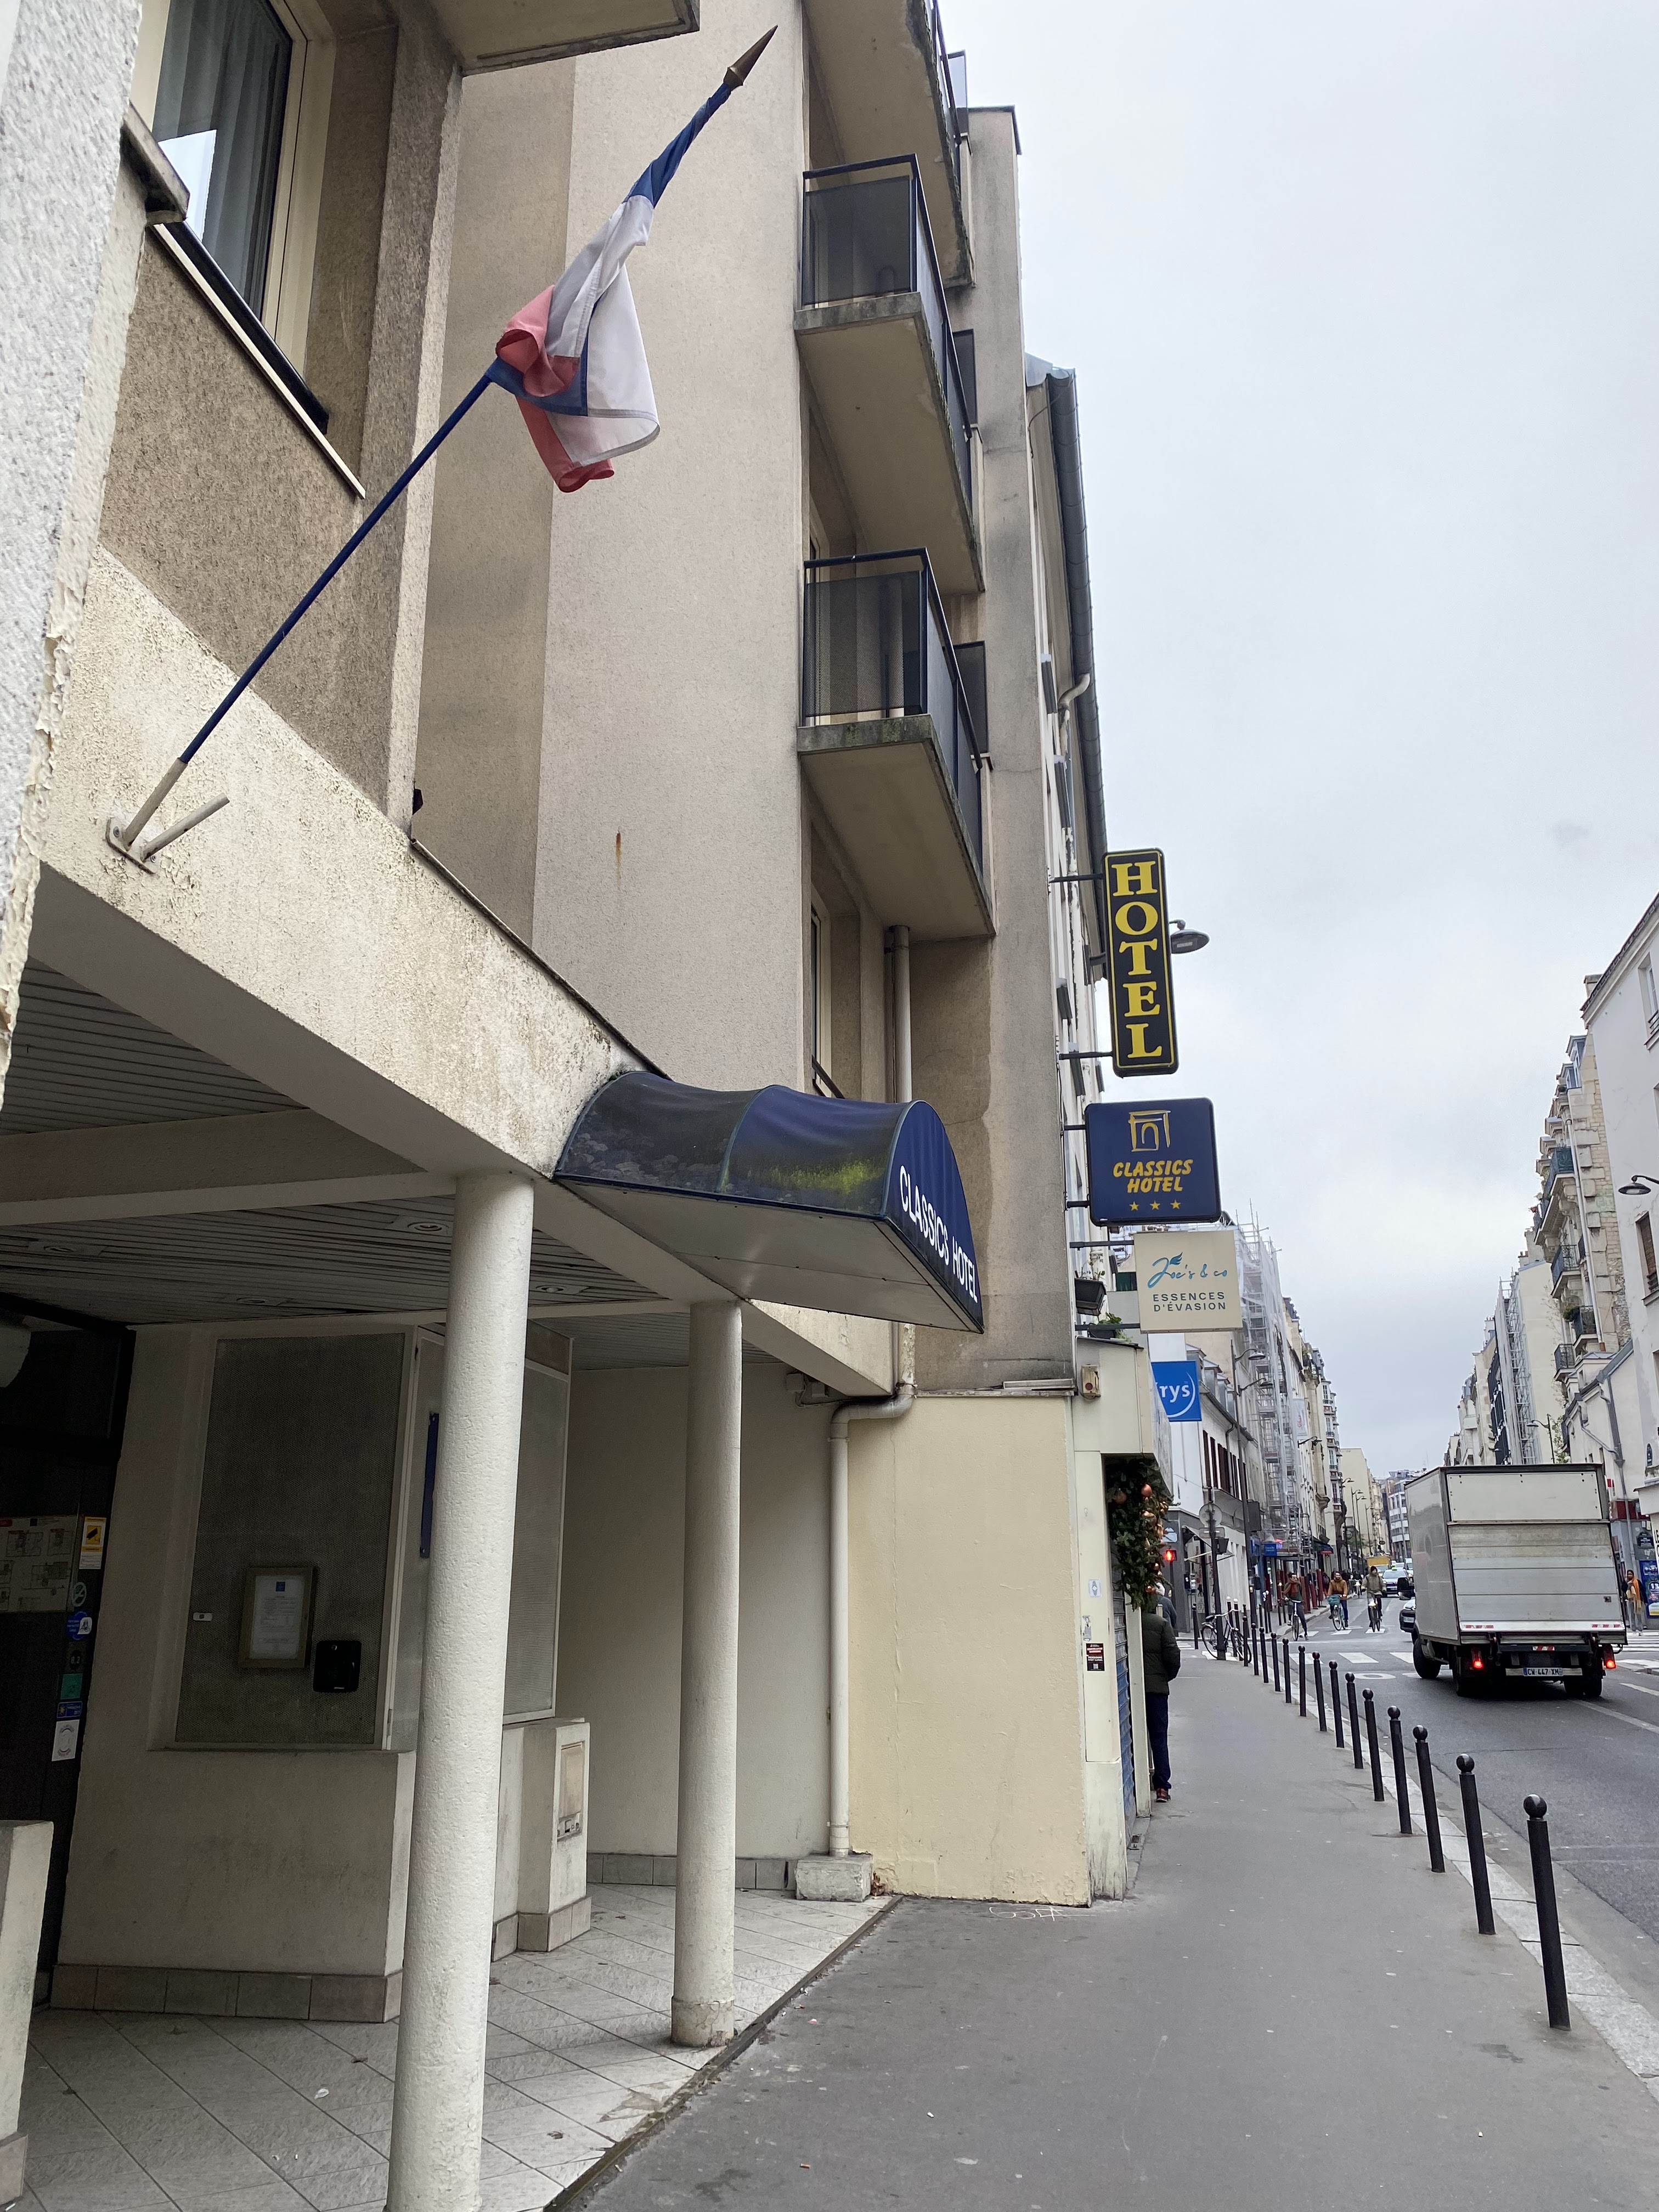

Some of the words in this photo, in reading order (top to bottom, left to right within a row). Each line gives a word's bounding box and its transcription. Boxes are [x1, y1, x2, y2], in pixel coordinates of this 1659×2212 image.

[1111, 861, 1163, 1059] HOTEL
[1113, 1159, 1193, 1178] CLASSICS
[1127, 1176, 1183, 1193] HOTEL
[900, 1165, 949, 1266] CLASSICS
[952, 1235, 978, 1304] HOTEL
[1200, 1263, 1208, 1278] &
[1153, 1291, 1225, 1302] ESSENCES
[1153, 1301, 1226, 1312] D'ÉVASION
[1155, 1381, 1190, 1403] rys
